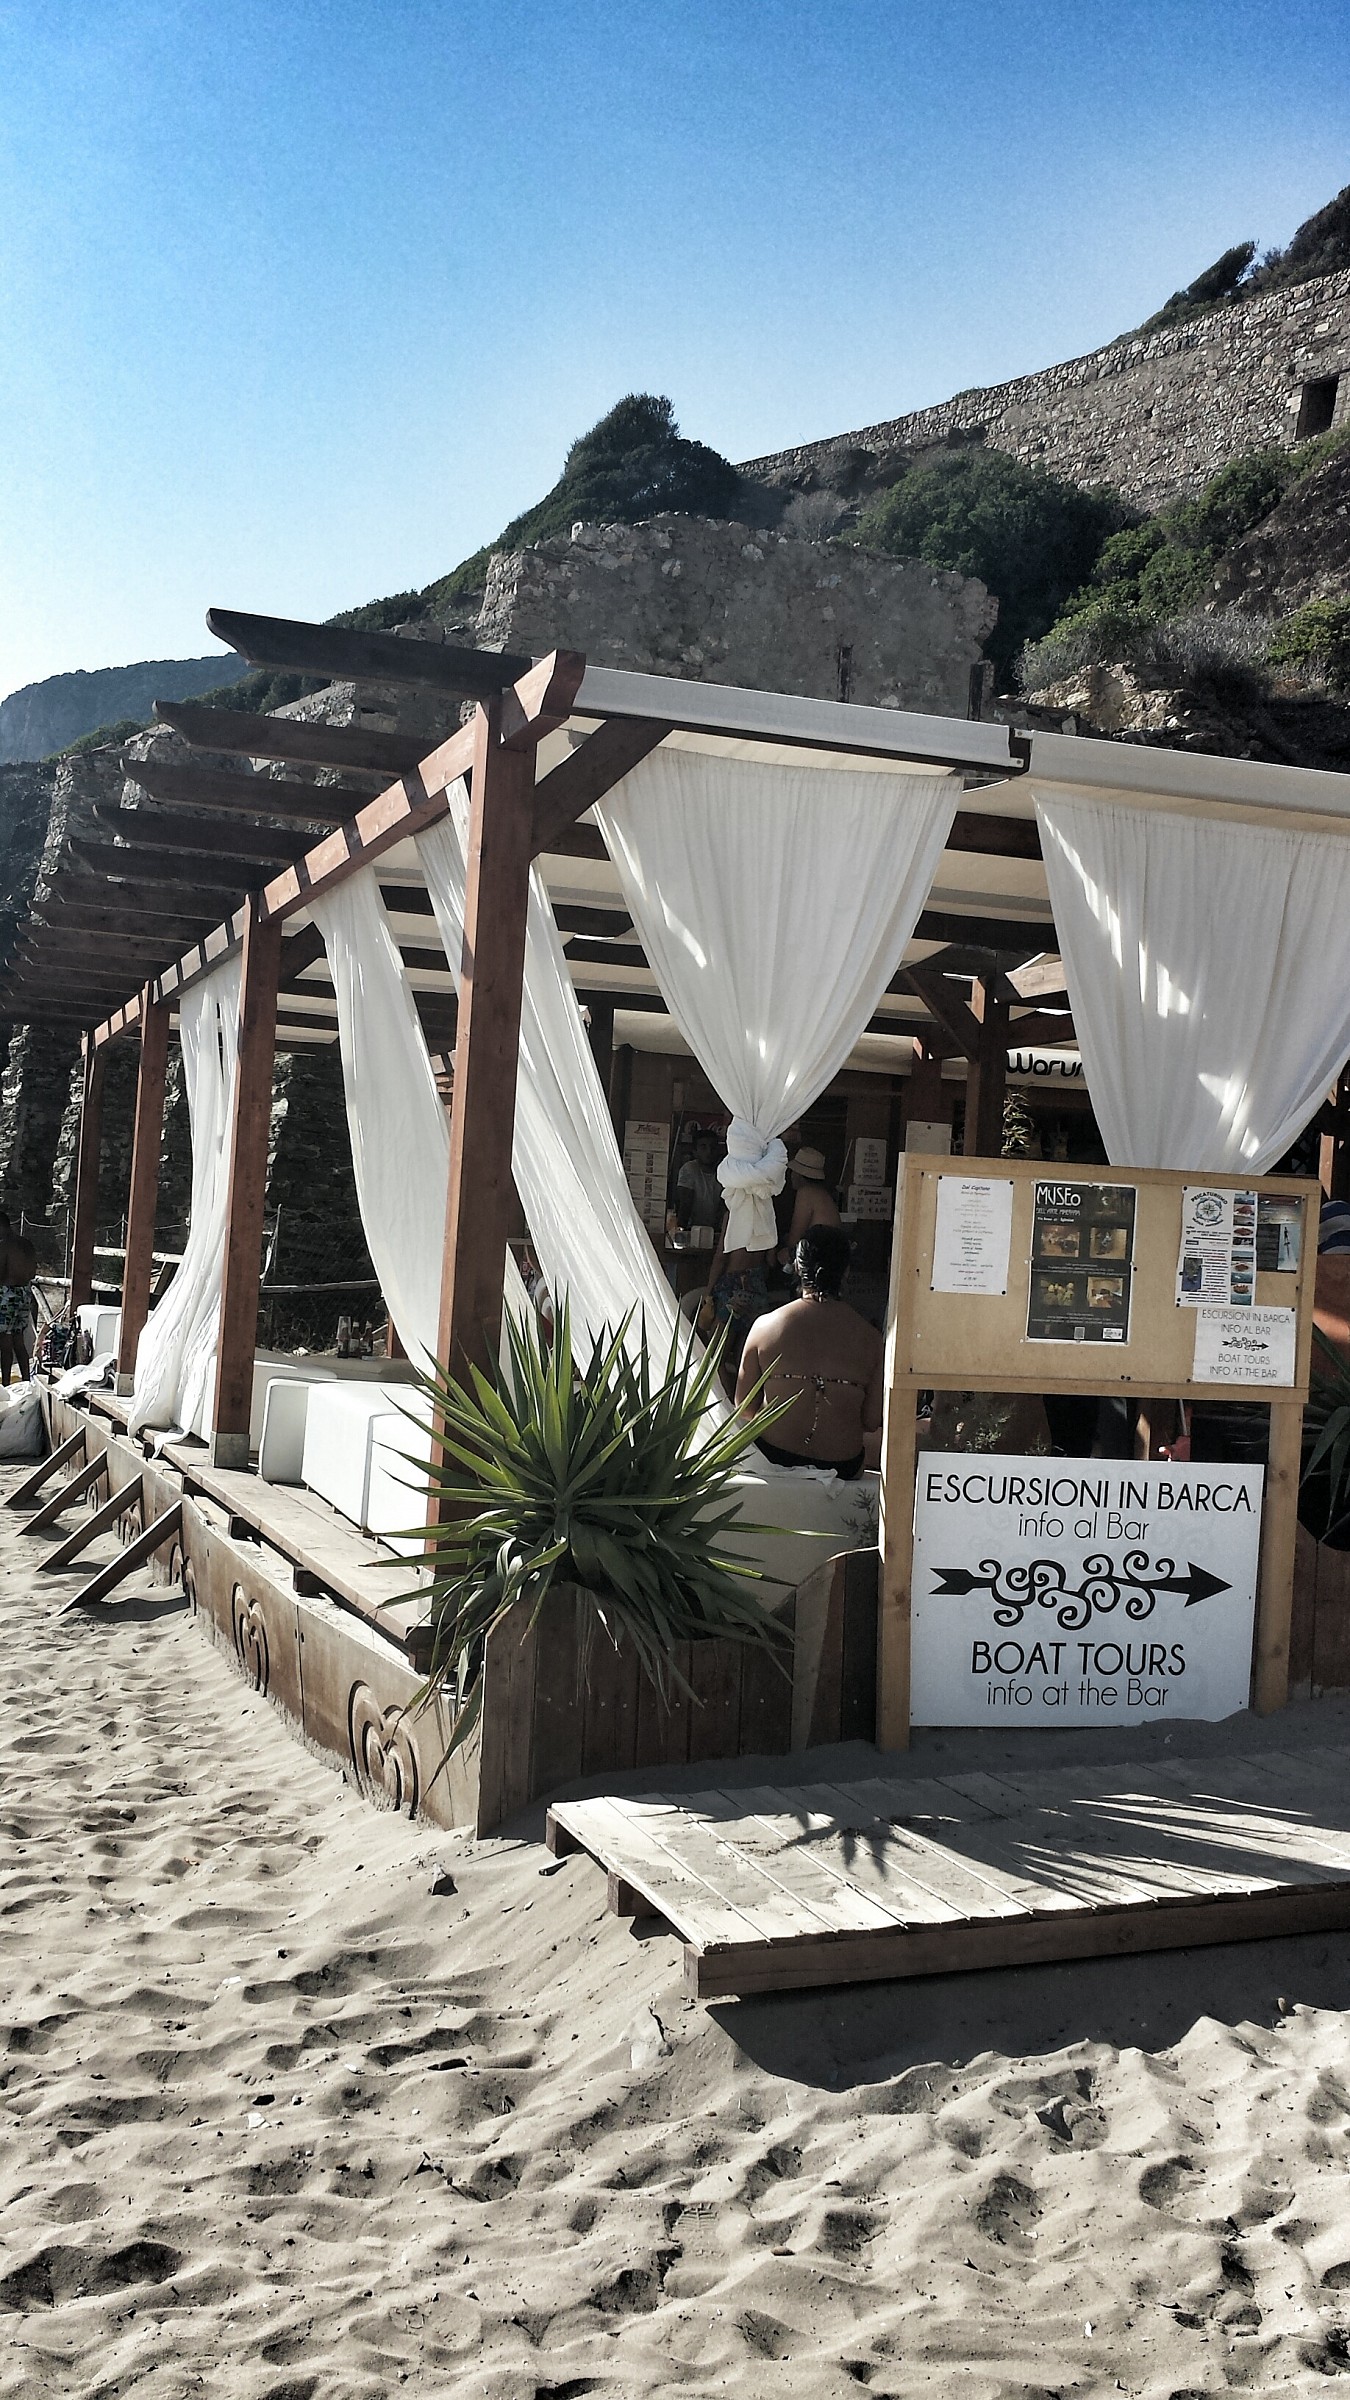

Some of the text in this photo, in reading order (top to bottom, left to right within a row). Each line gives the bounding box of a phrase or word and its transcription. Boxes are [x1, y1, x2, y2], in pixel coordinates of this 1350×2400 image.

[1006, 1052, 1083, 1078] Waru
[1202, 1309, 1291, 1324] ESCURSIONI IN BARCA
[1221, 1324, 1271, 1336] INFO AL BAR
[1218, 1353, 1271, 1365] BOAT TOURS
[1209, 1366, 1278, 1379] INFO AT THE BAR
[926, 1473, 1110, 1510] ESCURSIONI
[1118, 1480, 1149, 1510] IN
[1018, 1510, 1150, 1541] info al Bar
[971, 1640, 1186, 1677] BOAT TOURS
[986, 1677, 1170, 1707] info at the Bar
